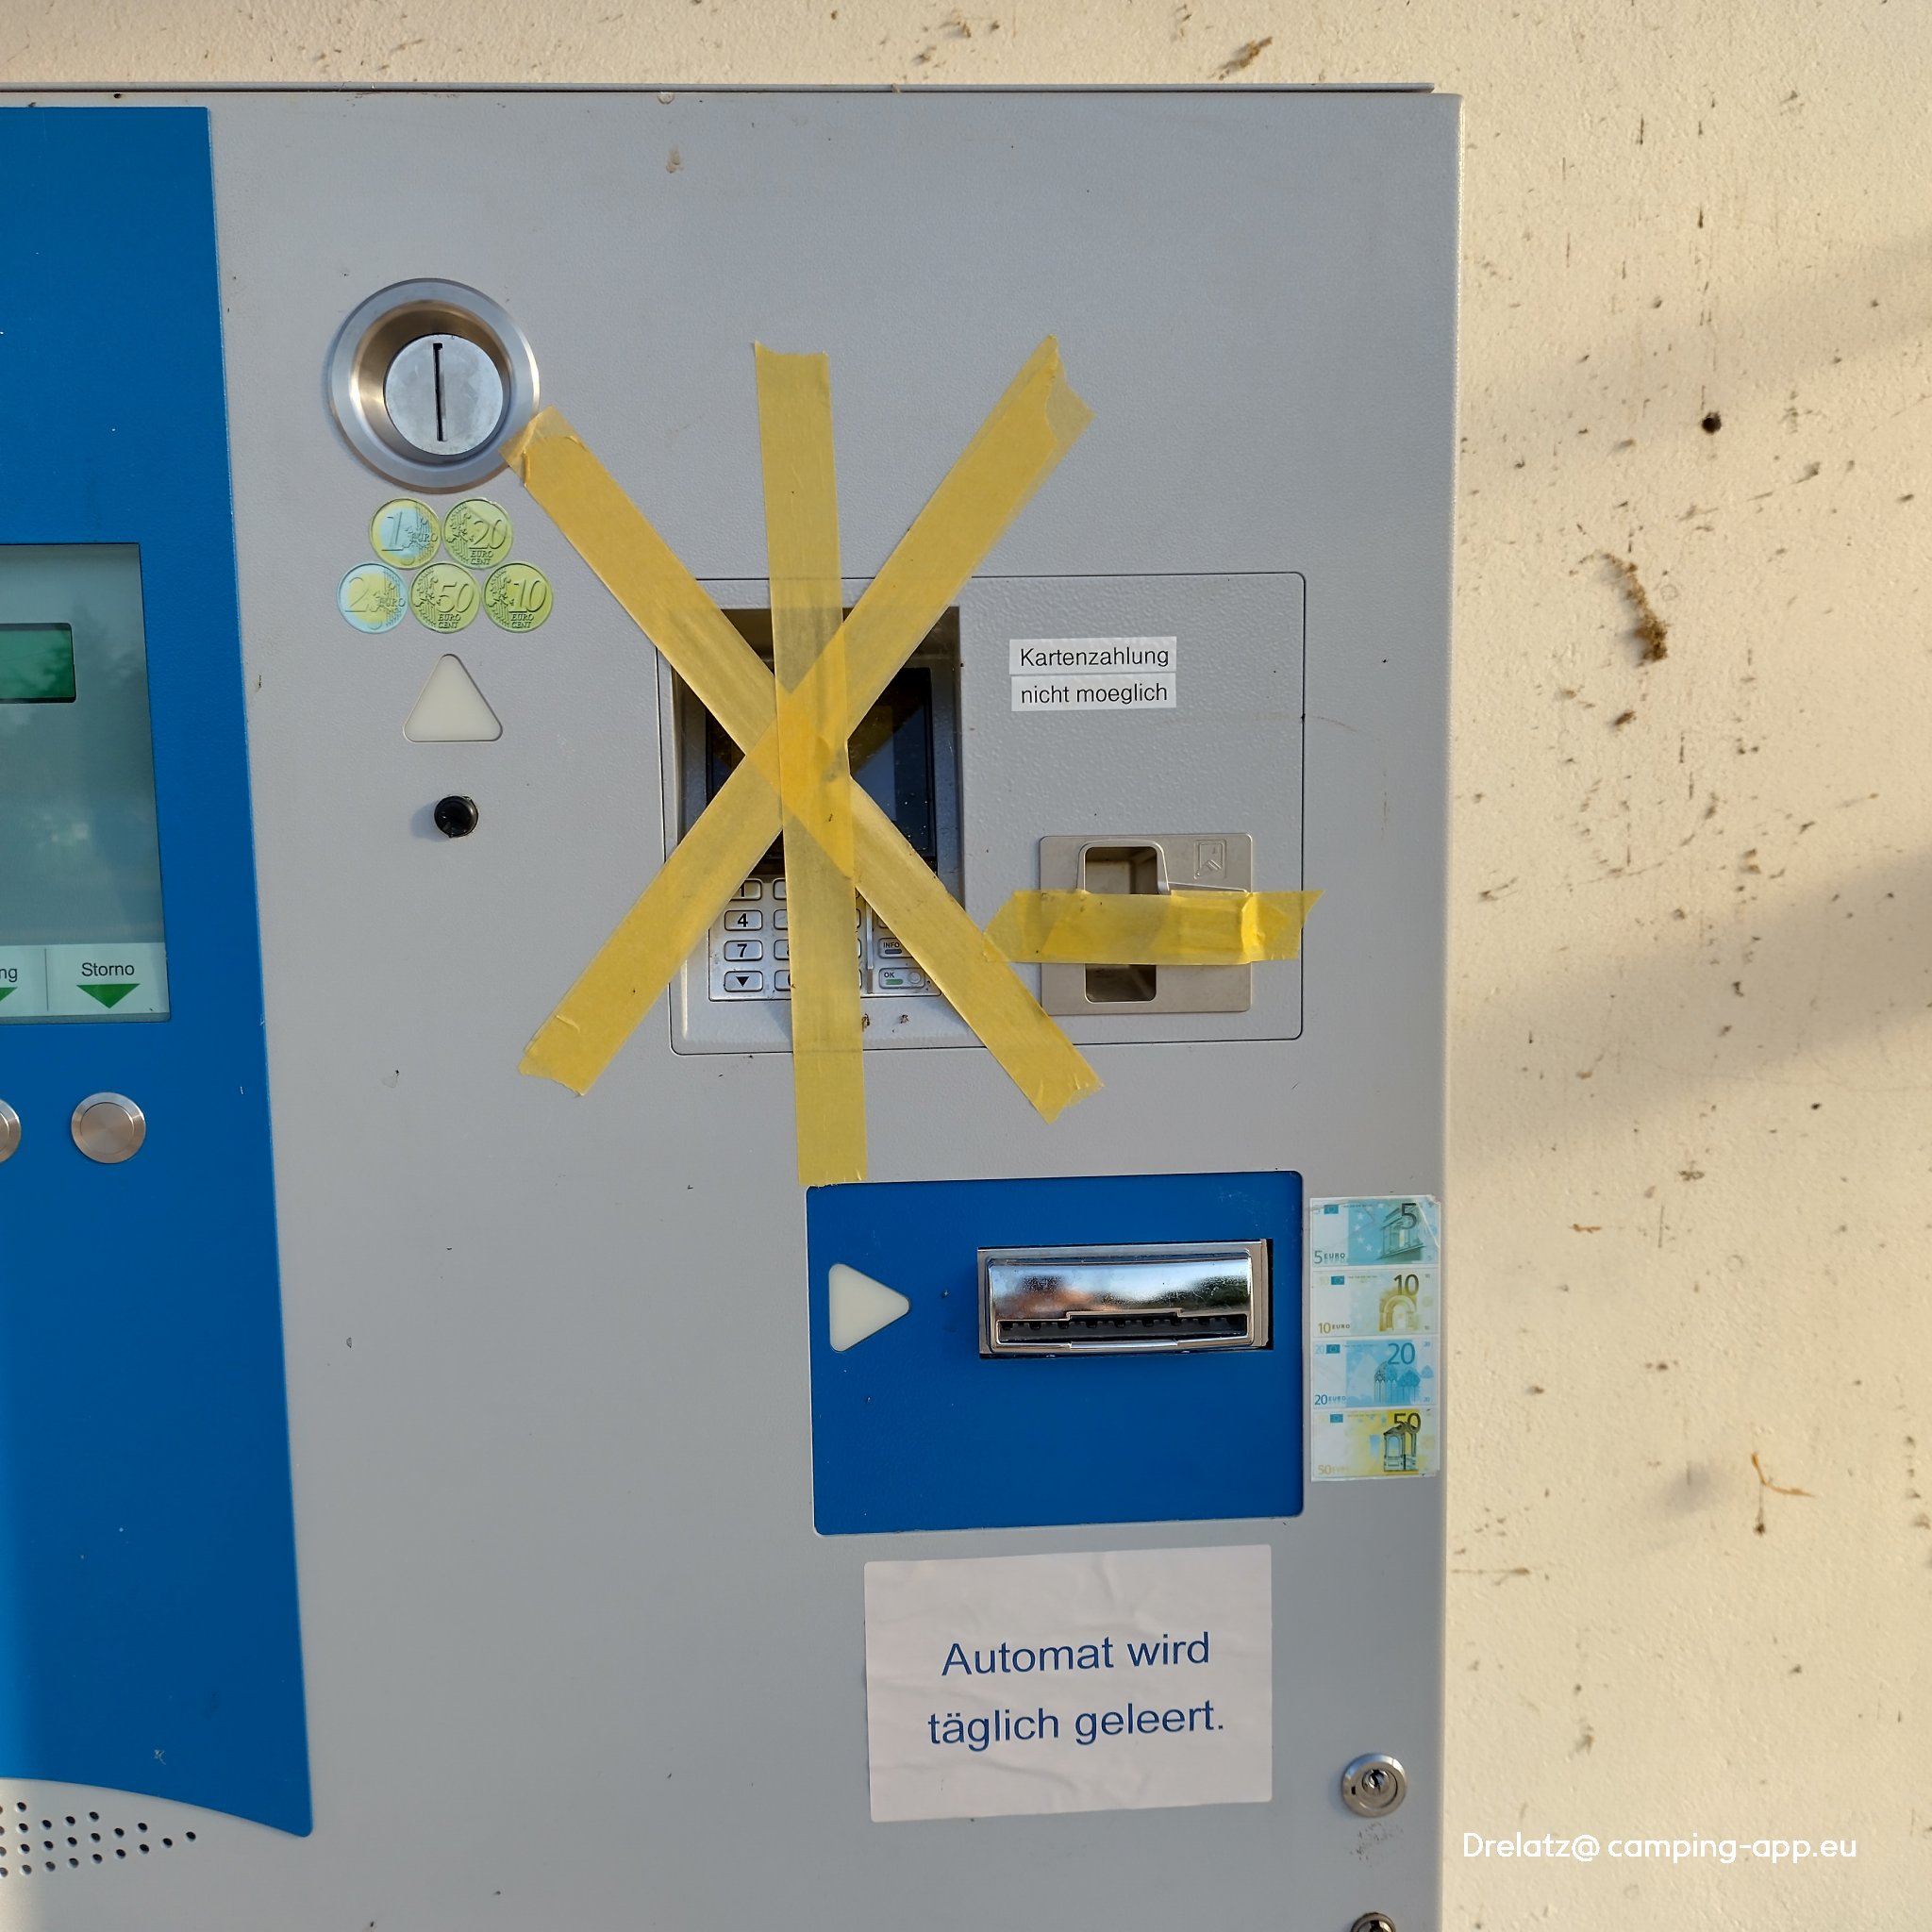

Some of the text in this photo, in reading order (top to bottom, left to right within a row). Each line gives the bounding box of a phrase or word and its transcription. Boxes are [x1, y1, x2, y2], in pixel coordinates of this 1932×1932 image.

[381, 511, 403, 552] 1
[469, 519, 508, 550] 20
[470, 550, 494, 558] EURO
[344, 576, 369, 613] 2
[436, 583, 474, 613] 50
[508, 579, 548, 613] 10
[438, 613, 462, 622] EURO
[438, 621, 458, 629] CENT
[510, 613, 535, 622] EURO
[1021, 646, 1169, 668] Kartenzahlung
[1022, 683, 1168, 705] nicht moeglich
[737, 912, 749, 928] 4
[737, 943, 748, 958] 7
[81, 961, 136, 977] Storno
[1401, 1203, 1418, 1229] 5
[1314, 1250, 1323, 1264] 5
[1393, 1274, 1420, 1296] 10
[1318, 1322, 1331, 1334] 10
[1387, 1341, 1416, 1365] 20
[1314, 1394, 1328, 1406] 20
[1393, 1412, 1422, 1435] 50
[941, 1631, 1210, 1676] Automat wird
[927, 1700, 1224, 1753] täglich geleert.
